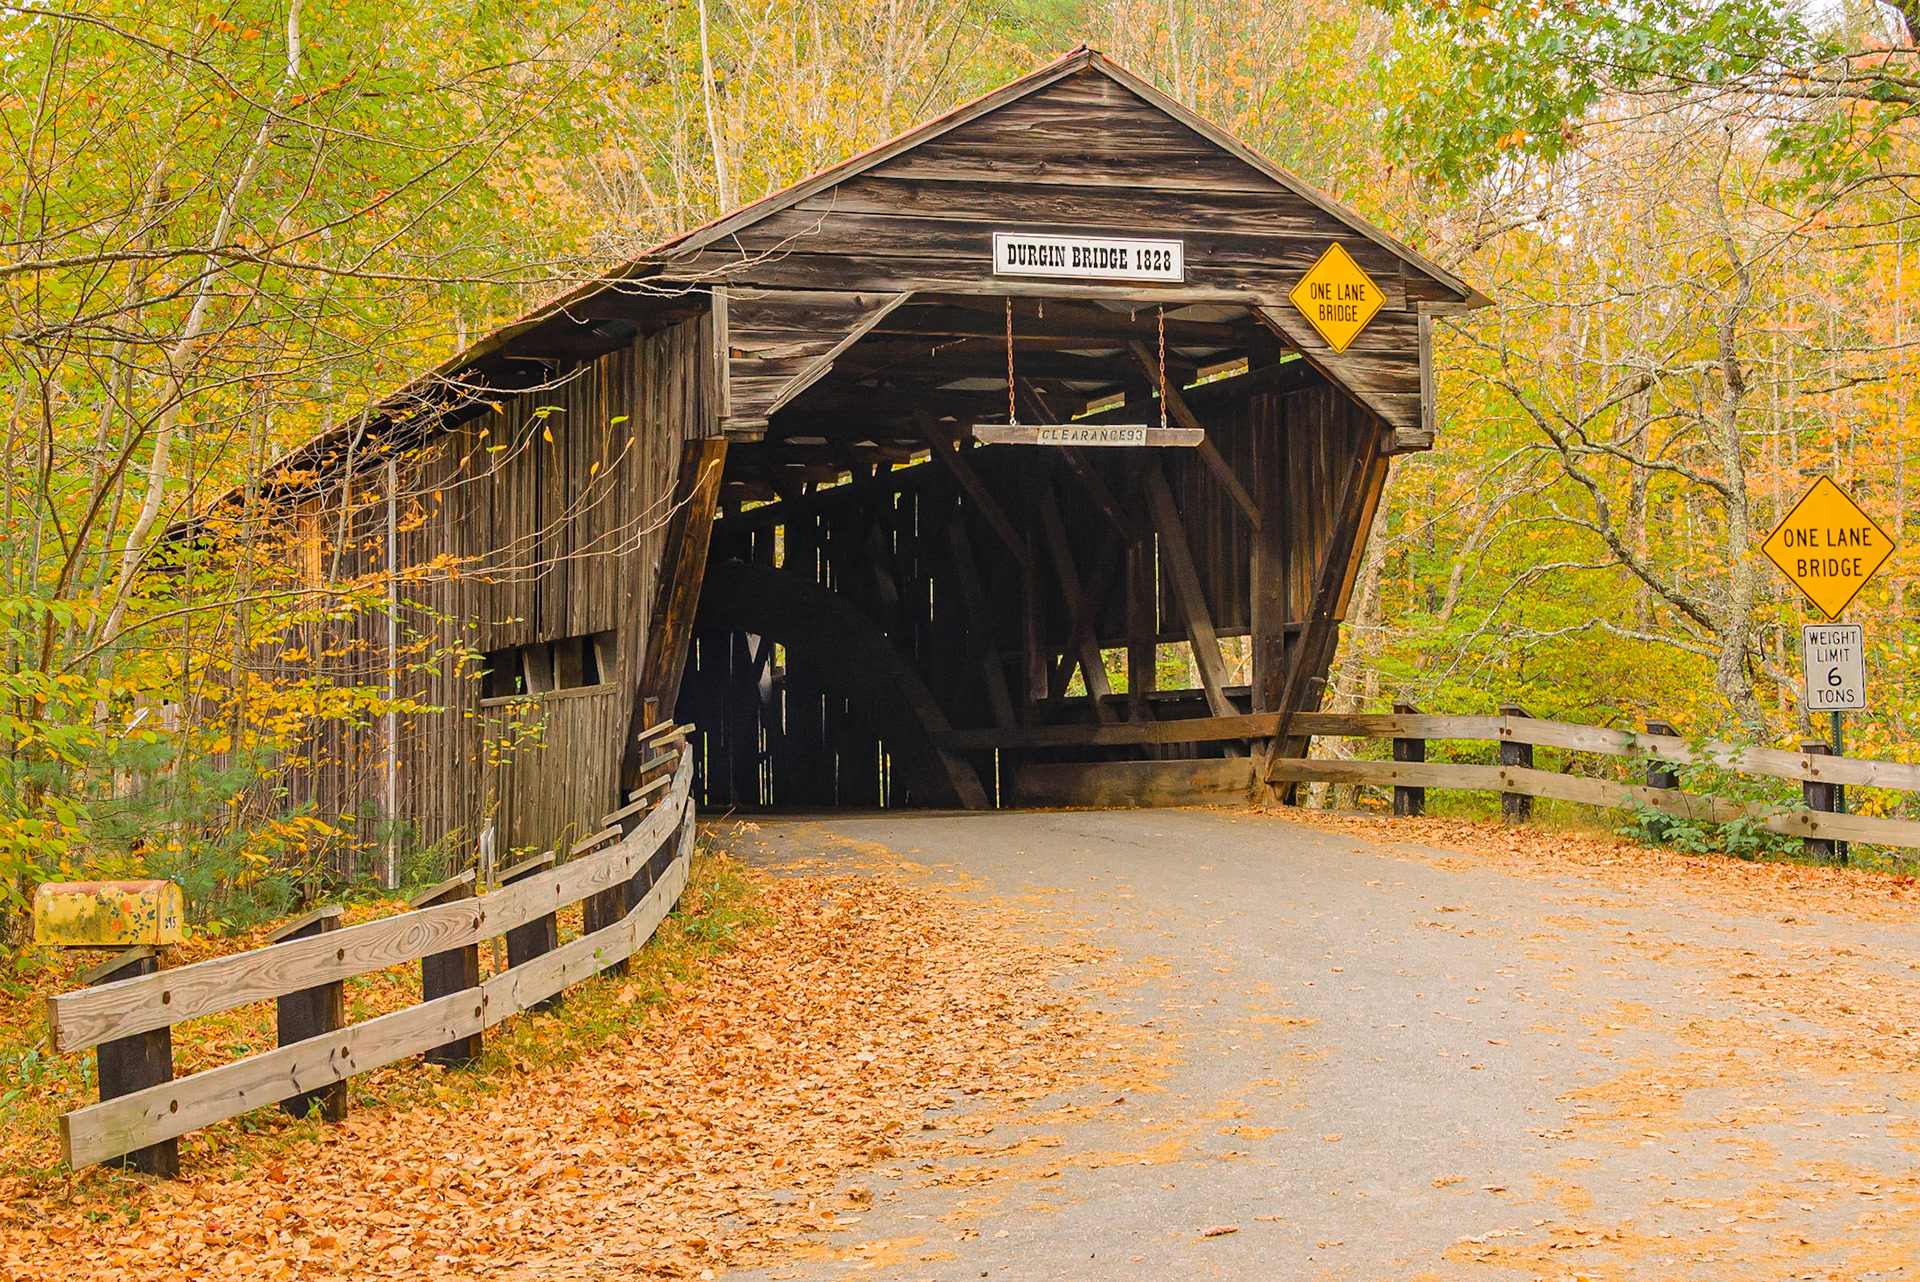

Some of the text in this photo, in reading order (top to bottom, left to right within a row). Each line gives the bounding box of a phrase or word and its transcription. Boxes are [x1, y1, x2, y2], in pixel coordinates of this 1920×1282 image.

[1007, 244, 1171, 272] DURGIN BRIDGE 1828
[1310, 282, 1366, 301] ONE LANE
[1319, 304, 1359, 322] BRIDGE
[1784, 527, 1872, 547] ONE LANE
[1797, 558, 1863, 577] BRIDGE
[1809, 631, 1857, 645] WEIGHT
[1816, 648, 1850, 663] LIMIT
[1827, 667, 1842, 686] 6
[1816, 689, 1855, 703] TONS
